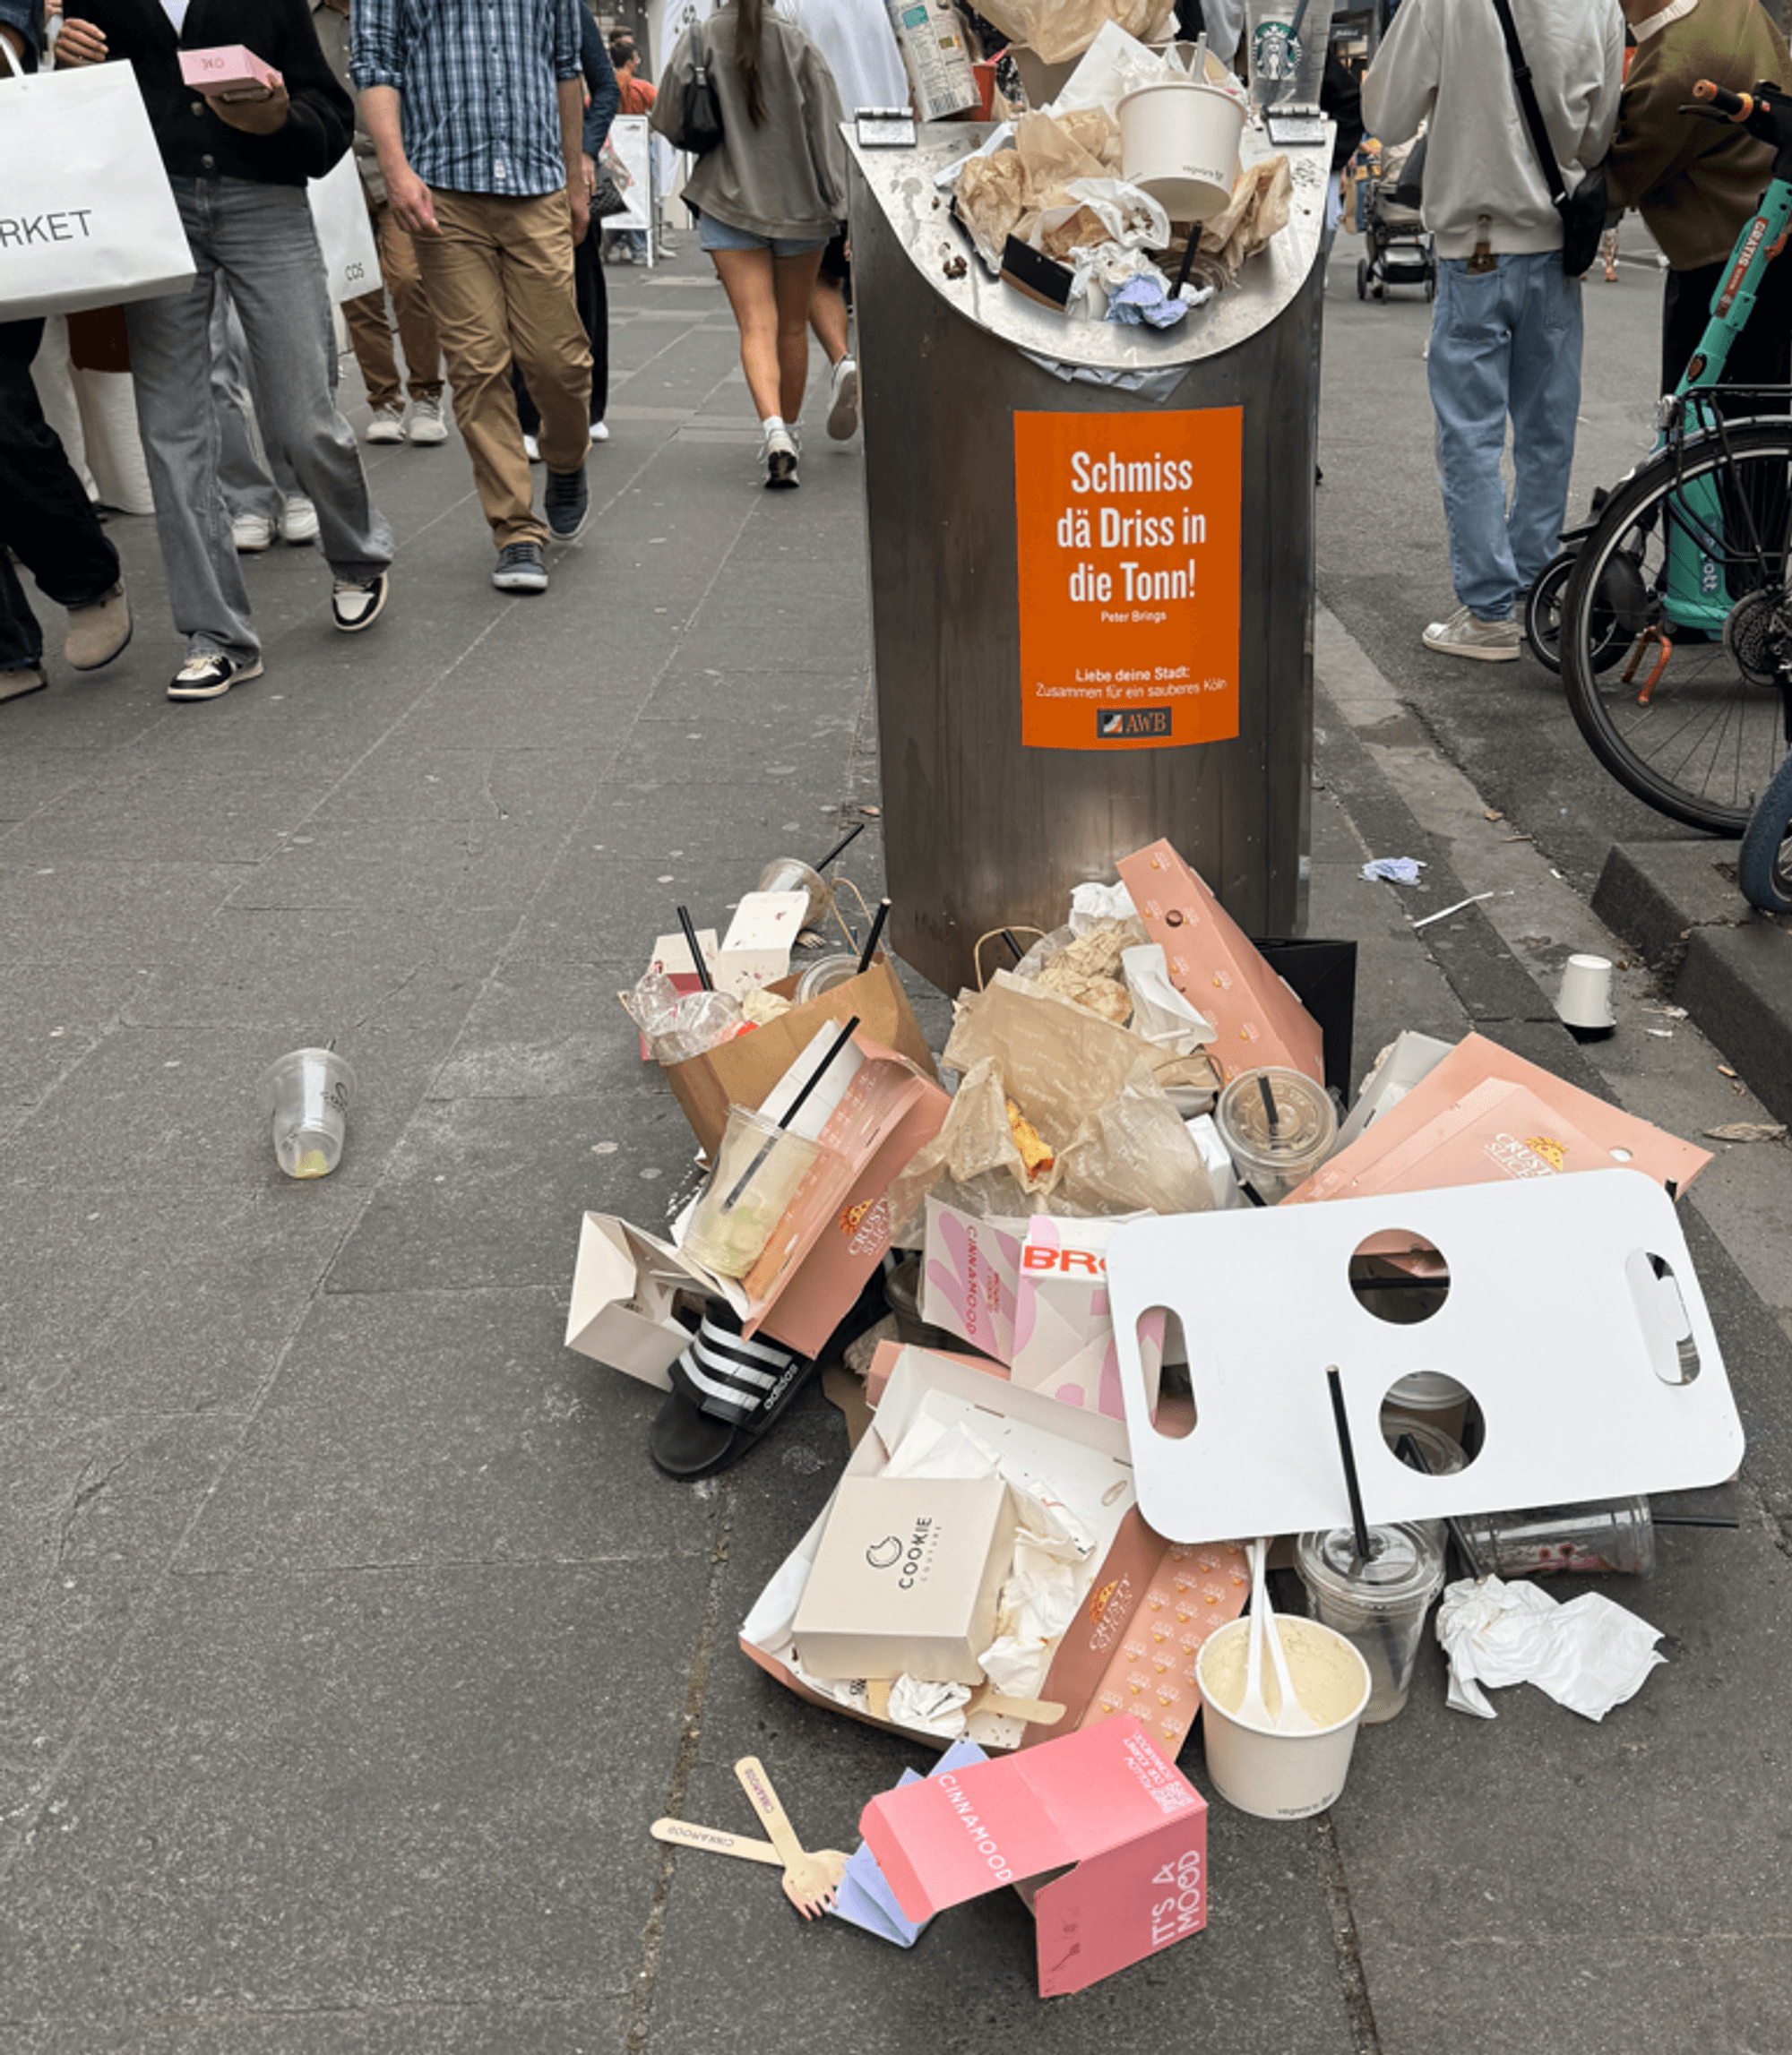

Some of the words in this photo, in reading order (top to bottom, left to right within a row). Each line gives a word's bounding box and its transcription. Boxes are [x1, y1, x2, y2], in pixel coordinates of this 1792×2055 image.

[345, 262, 364, 281] COS
[1071, 451, 1193, 493] Schmiss
[1056, 507, 1091, 548] dä
[1100, 507, 1175, 548] Driss
[1182, 506, 1206, 545] in
[1069, 563, 1112, 602] die
[1119, 558, 1195, 602] Tonn!
[1100, 610, 1129, 623] Peter
[1131, 610, 1167, 624] Brings
[1036, 683, 1103, 699] Zusammen
[1106, 684, 1123, 699] für
[1125, 686, 1144, 699] ein
[1147, 683, 1201, 698] sauberes
[1203, 677, 1228, 692] Köln
[1075, 668, 1112, 682] Liebe
[1115, 668, 1150, 682] deine
[1154, 666, 1191, 680] Stadt:
[1125, 712, 1167, 734] AWB
[966, 1225, 978, 1335] CINNAMOOD
[1023, 1245, 1106, 1274] BR
[763, 1363, 799, 1410] adidas
[898, 1518, 933, 1590] COOKIE
[939, 1774, 1012, 1881] CINNAMOOD
[1151, 1862, 1176, 1883] A
[1176, 1850, 1201, 1932] MOOD
[1151, 1897, 1176, 1946] IT'S
